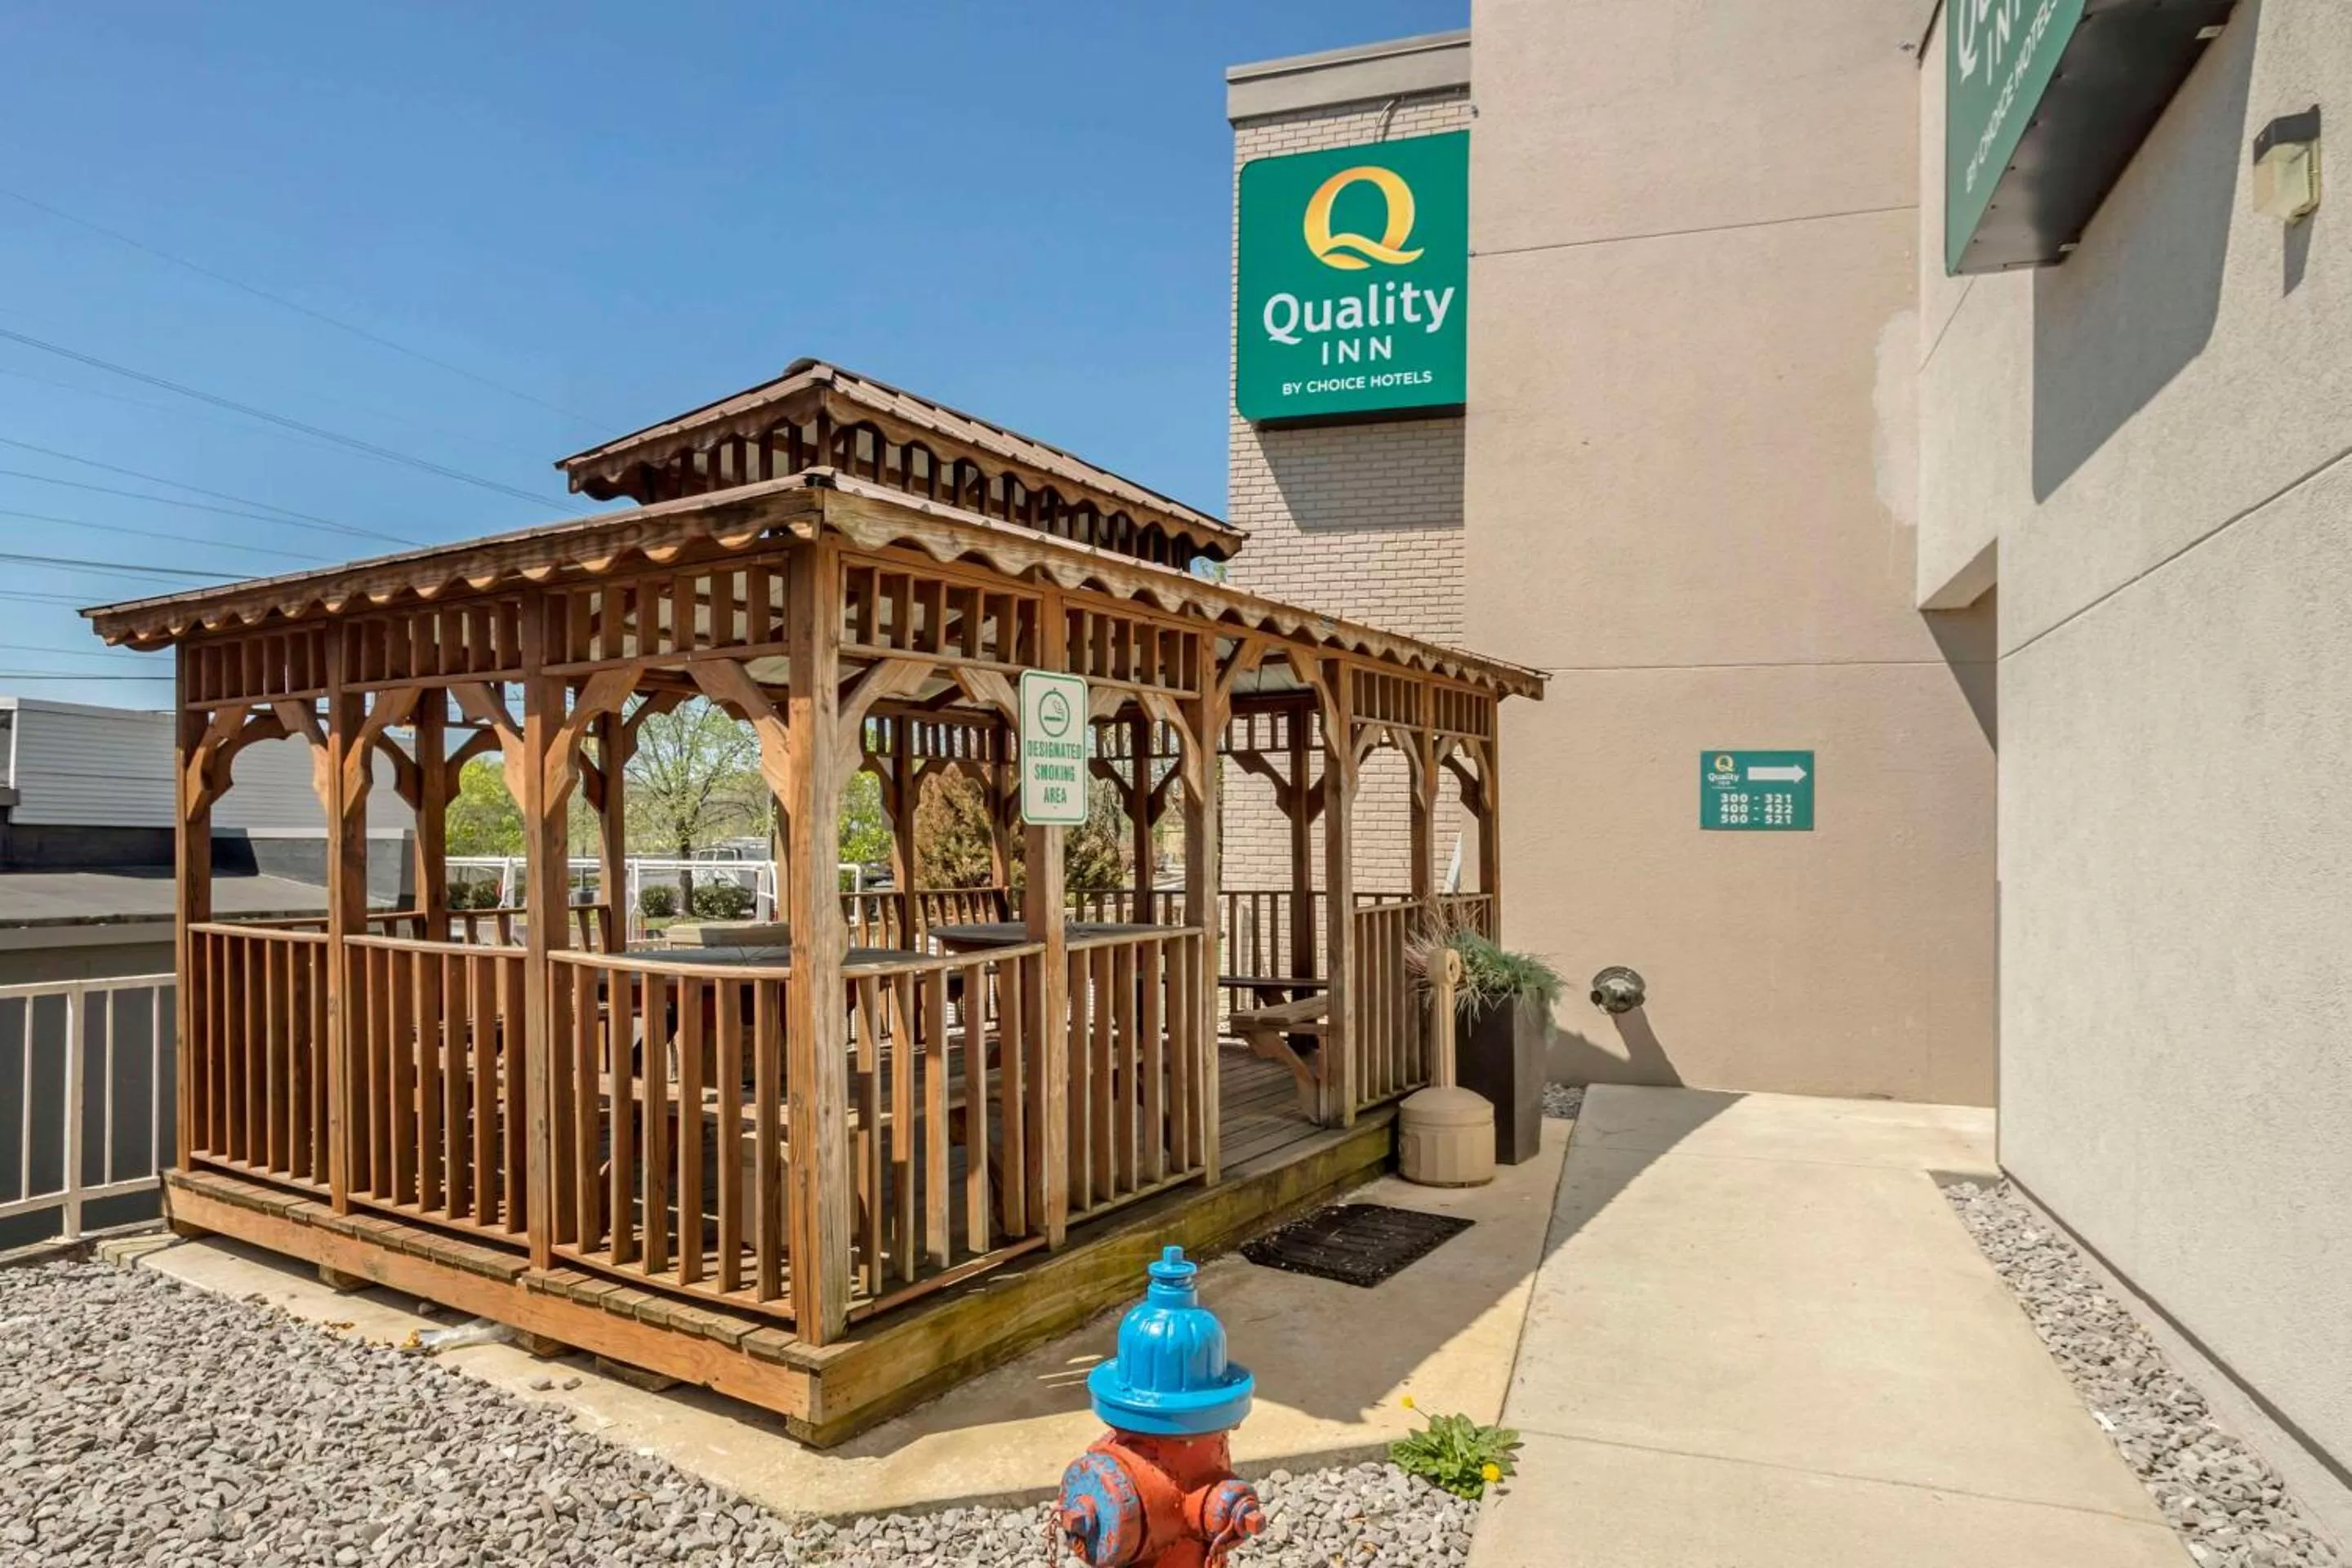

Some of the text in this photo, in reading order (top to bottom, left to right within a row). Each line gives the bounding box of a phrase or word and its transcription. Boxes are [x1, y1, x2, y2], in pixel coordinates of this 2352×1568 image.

[1978, 71, 2015, 165] CHOICE
[1303, 166, 1425, 270] Q
[1263, 281, 1456, 345] Quality
[1321, 335, 1392, 366] INN
[1281, 370, 1433, 396] BY CHOICE HOTELS
[1027, 739, 1082, 760] DESIGNATED
[1034, 763, 1076, 782] SMOKING
[1044, 786, 1067, 804] AREA
[1720, 804, 1748, 813] 400
